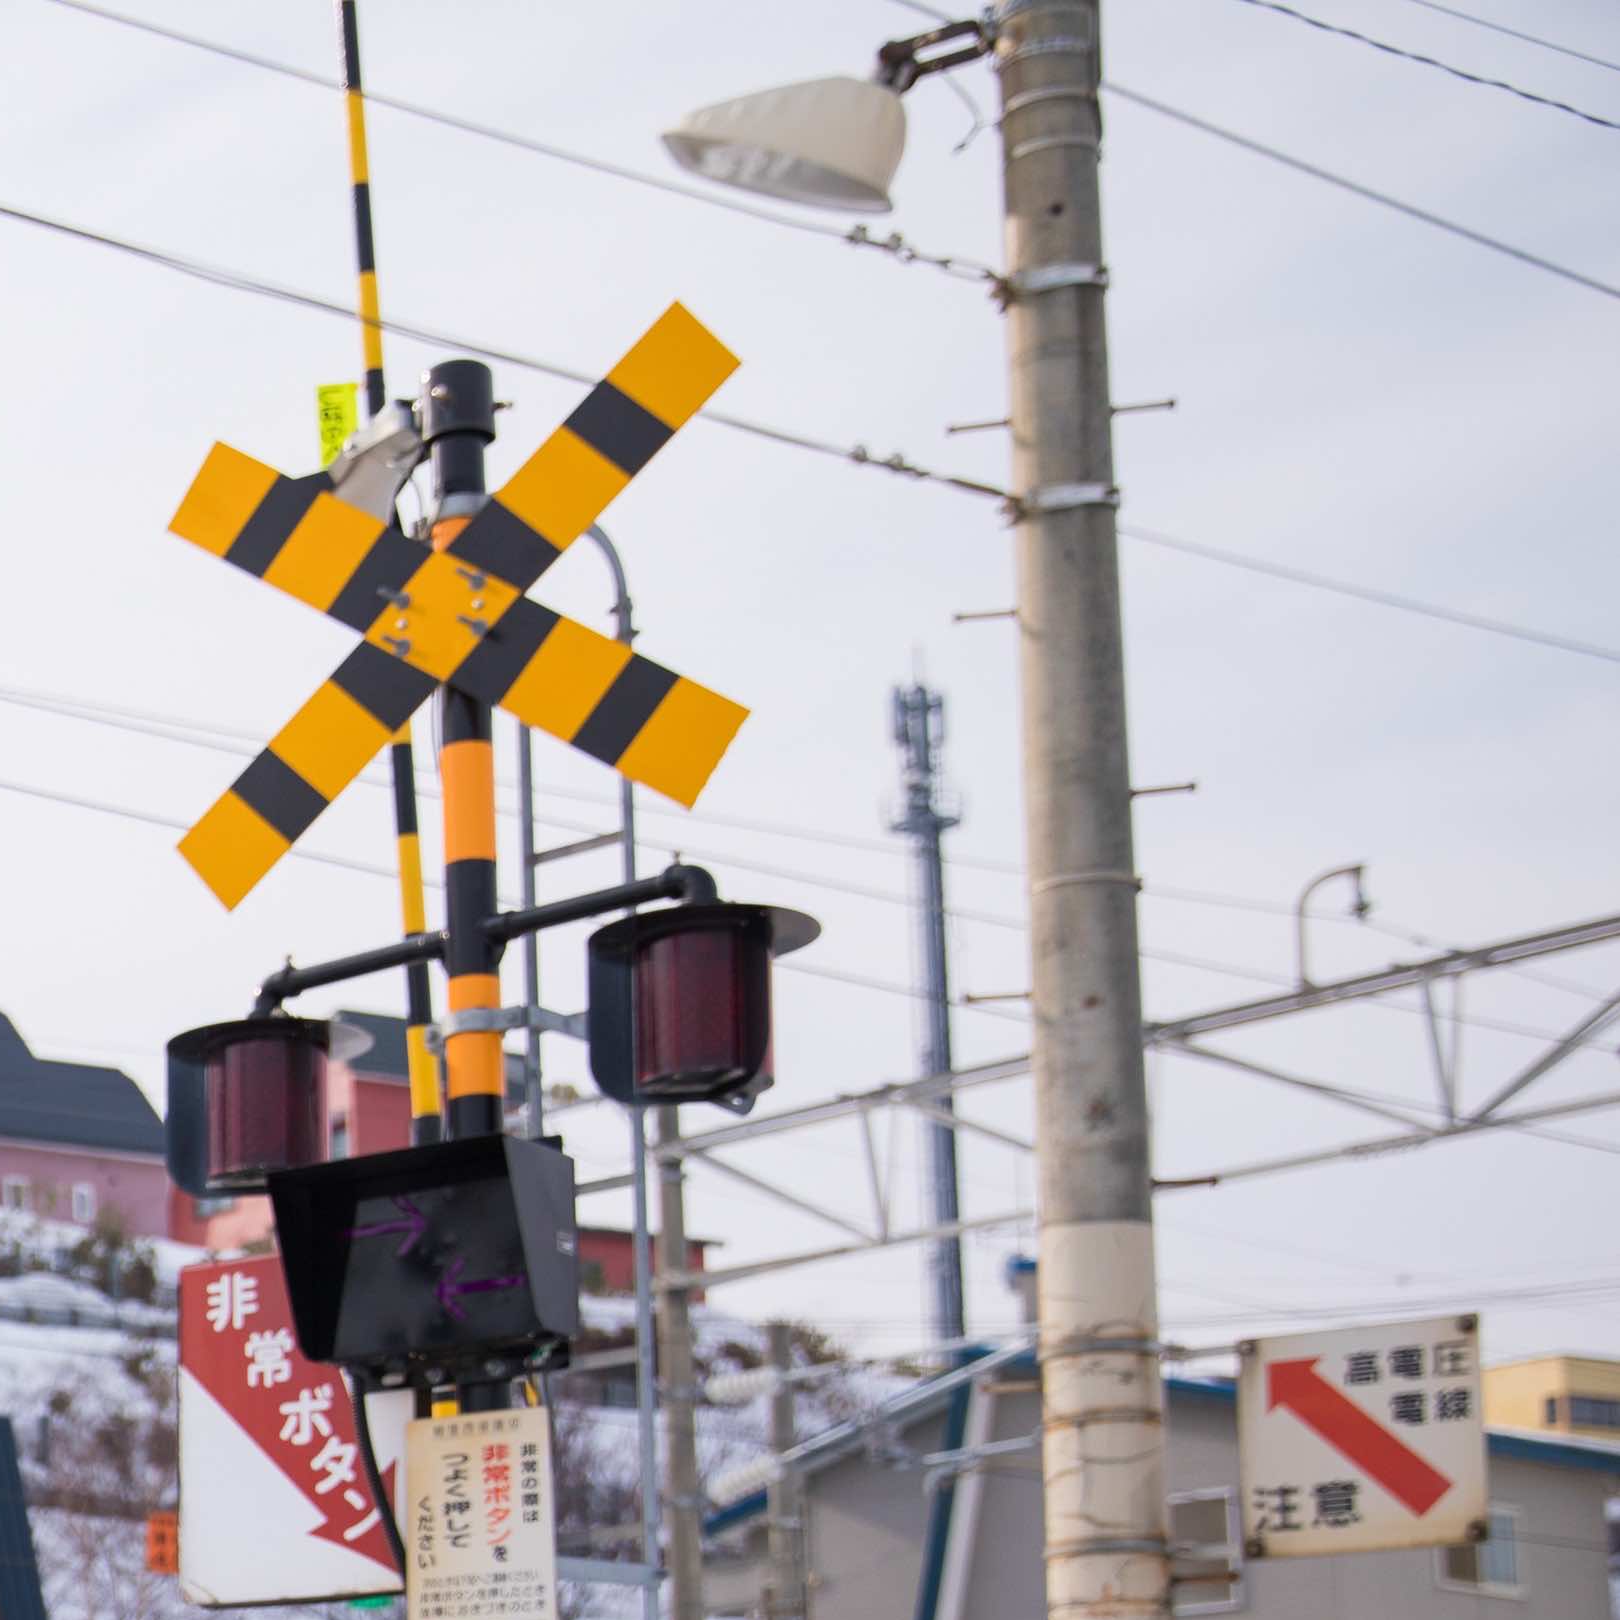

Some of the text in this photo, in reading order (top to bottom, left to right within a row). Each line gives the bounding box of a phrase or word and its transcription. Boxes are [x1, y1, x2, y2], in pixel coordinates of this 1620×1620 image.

[1345, 1339, 1472, 1386] 高電圧
[206, 1271, 382, 1541] 非常ボタン
[1391, 1387, 1472, 1425] 電線
[441, 1452, 471, 1548] つよく押して
[1253, 1480, 1362, 1532] 注意
[417, 1496, 436, 1569] ください
